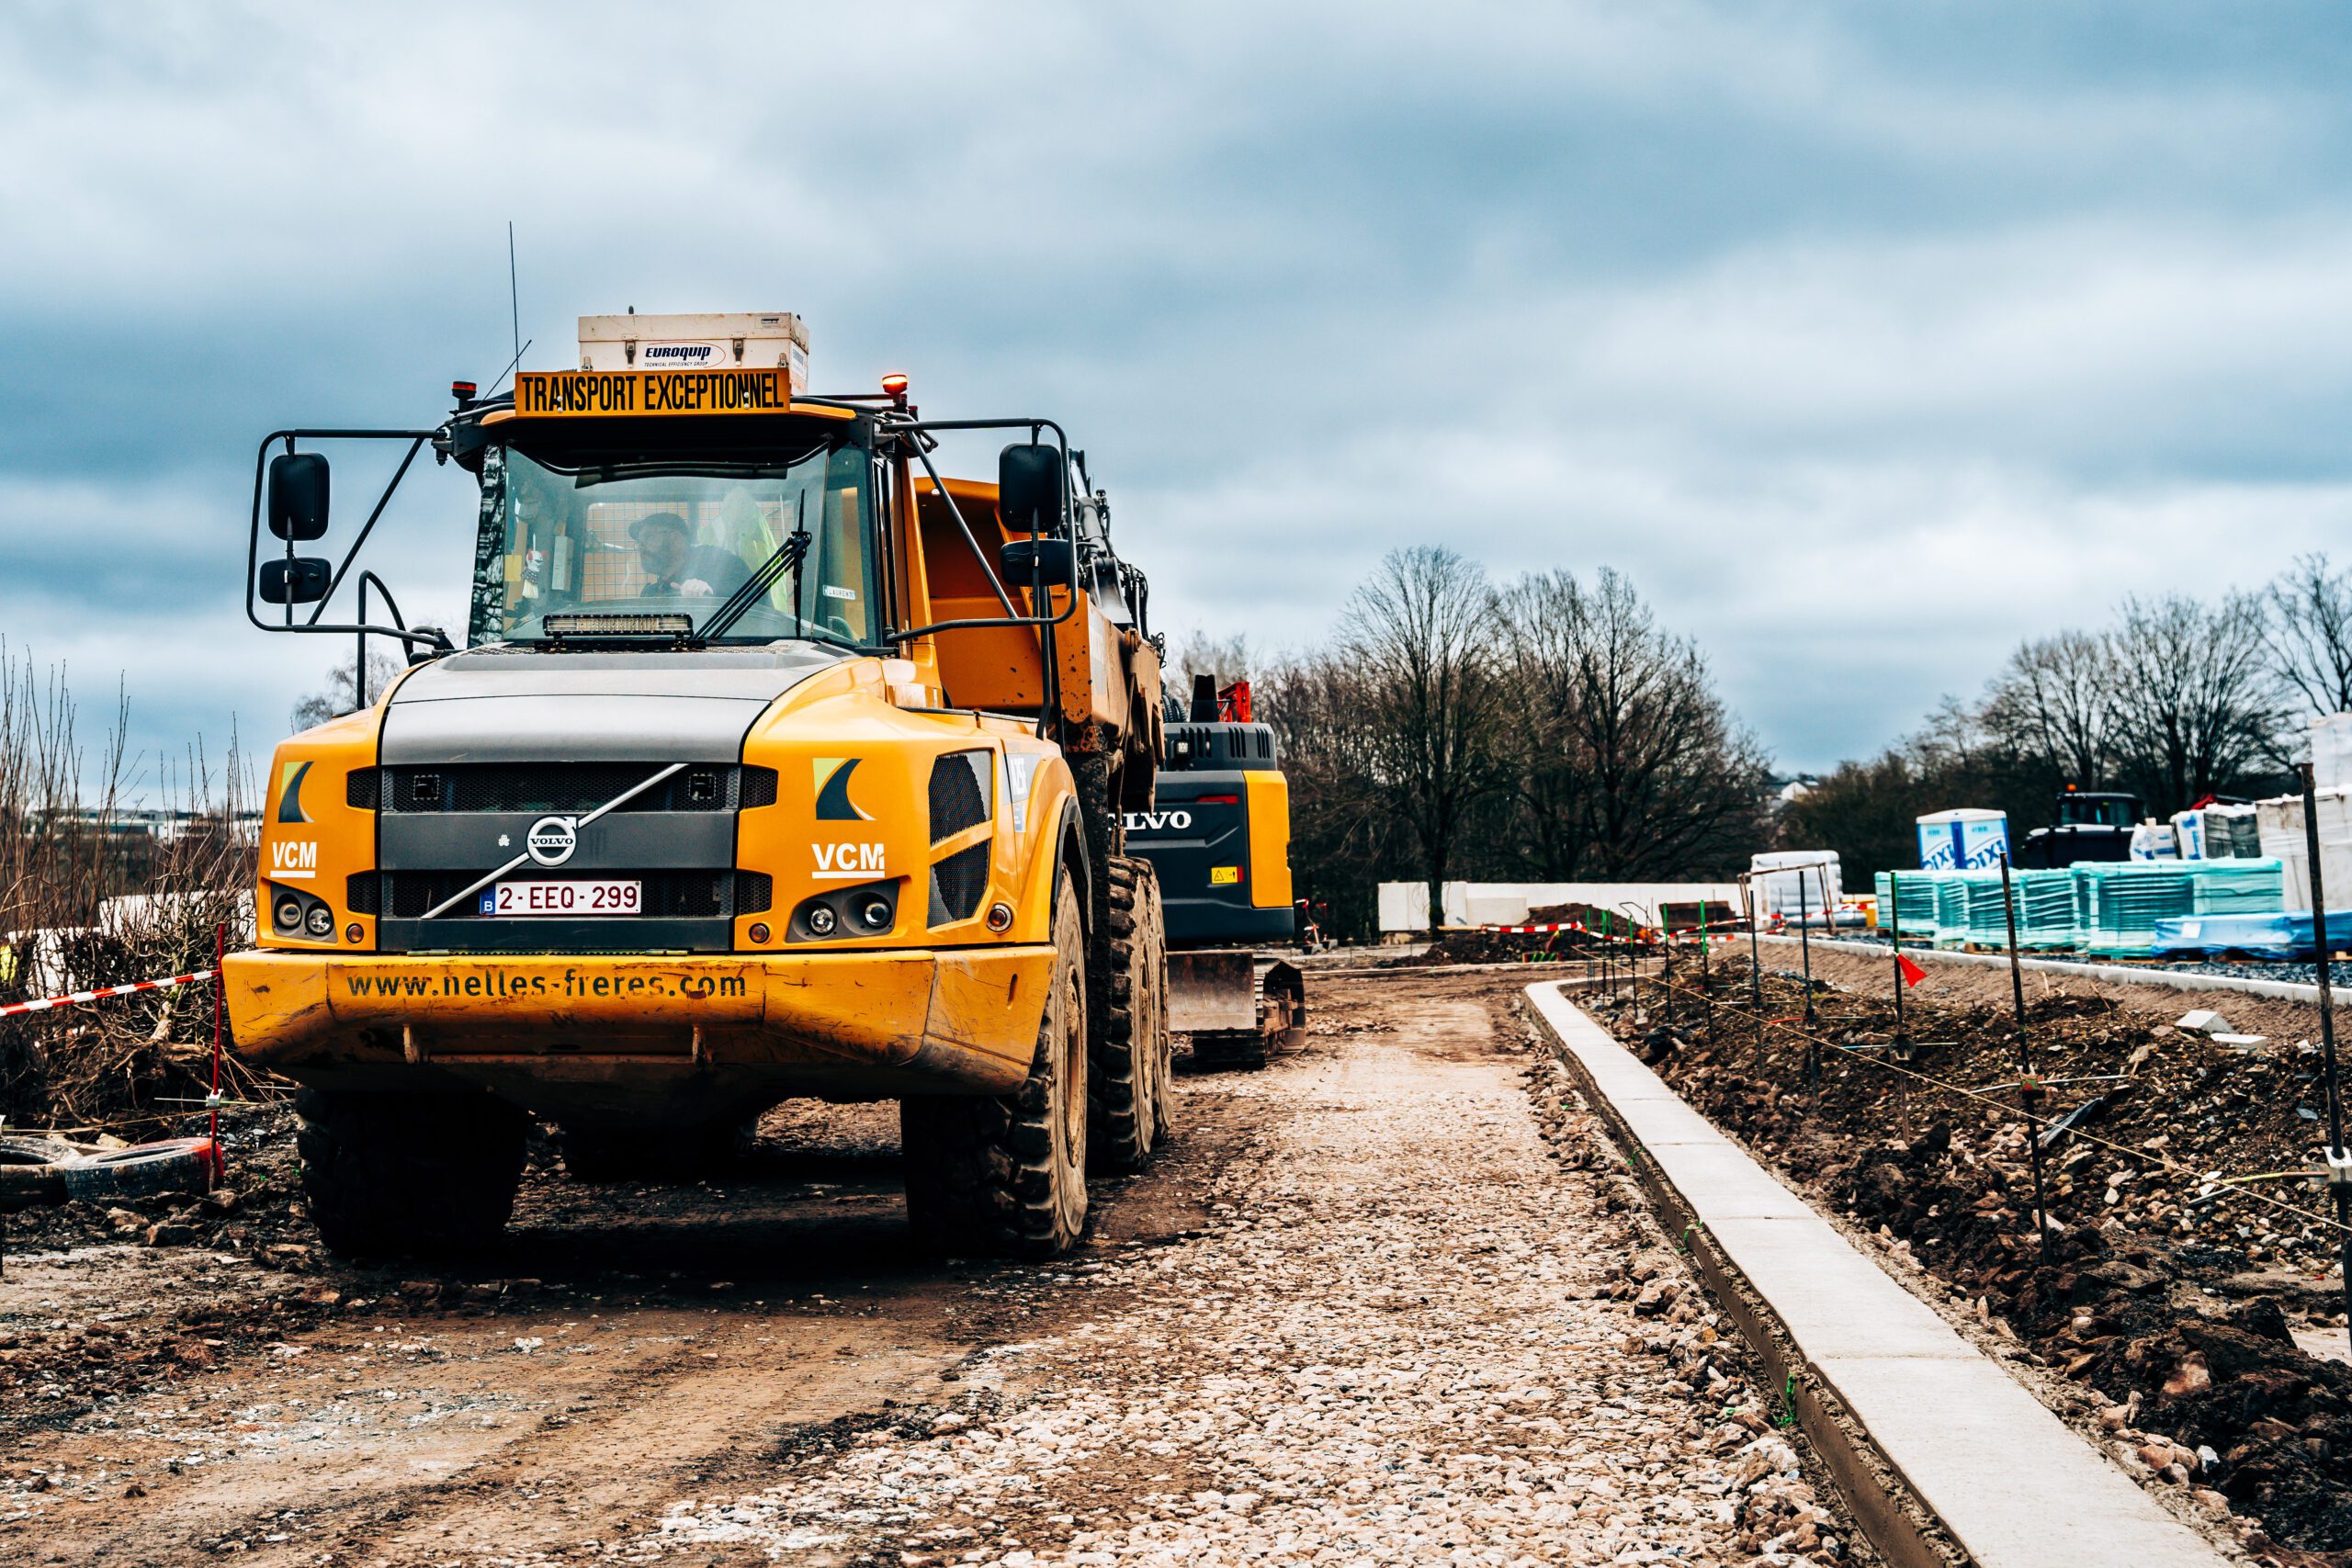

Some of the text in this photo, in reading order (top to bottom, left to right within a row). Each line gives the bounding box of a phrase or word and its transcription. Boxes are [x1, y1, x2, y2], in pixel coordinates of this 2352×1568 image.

[521, 372, 784, 412] TRANSPORT EXCEPTIONNEL
[272, 841, 317, 869] VCM
[530, 837, 574, 845] VOLVO
[811, 842, 885, 871] VCM
[483, 901, 493, 911] B
[347, 967, 746, 997] www.nelles-freres.com
